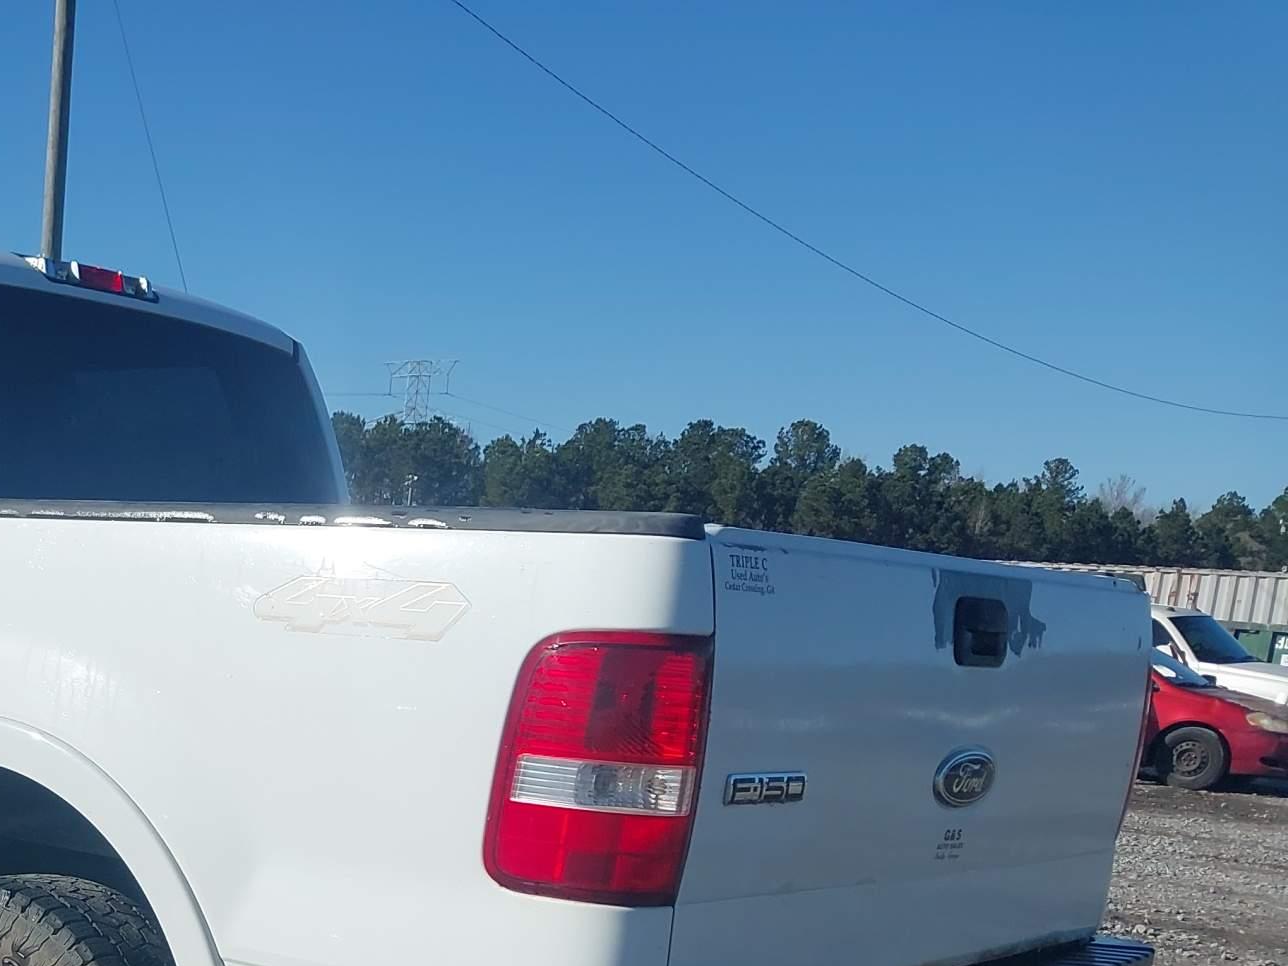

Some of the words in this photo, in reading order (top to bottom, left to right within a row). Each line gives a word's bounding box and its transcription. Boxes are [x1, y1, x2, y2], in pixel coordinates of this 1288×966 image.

[729, 554, 759, 569] TRIPLE
[762, 558, 768, 571] C
[731, 569, 747, 581] Used
